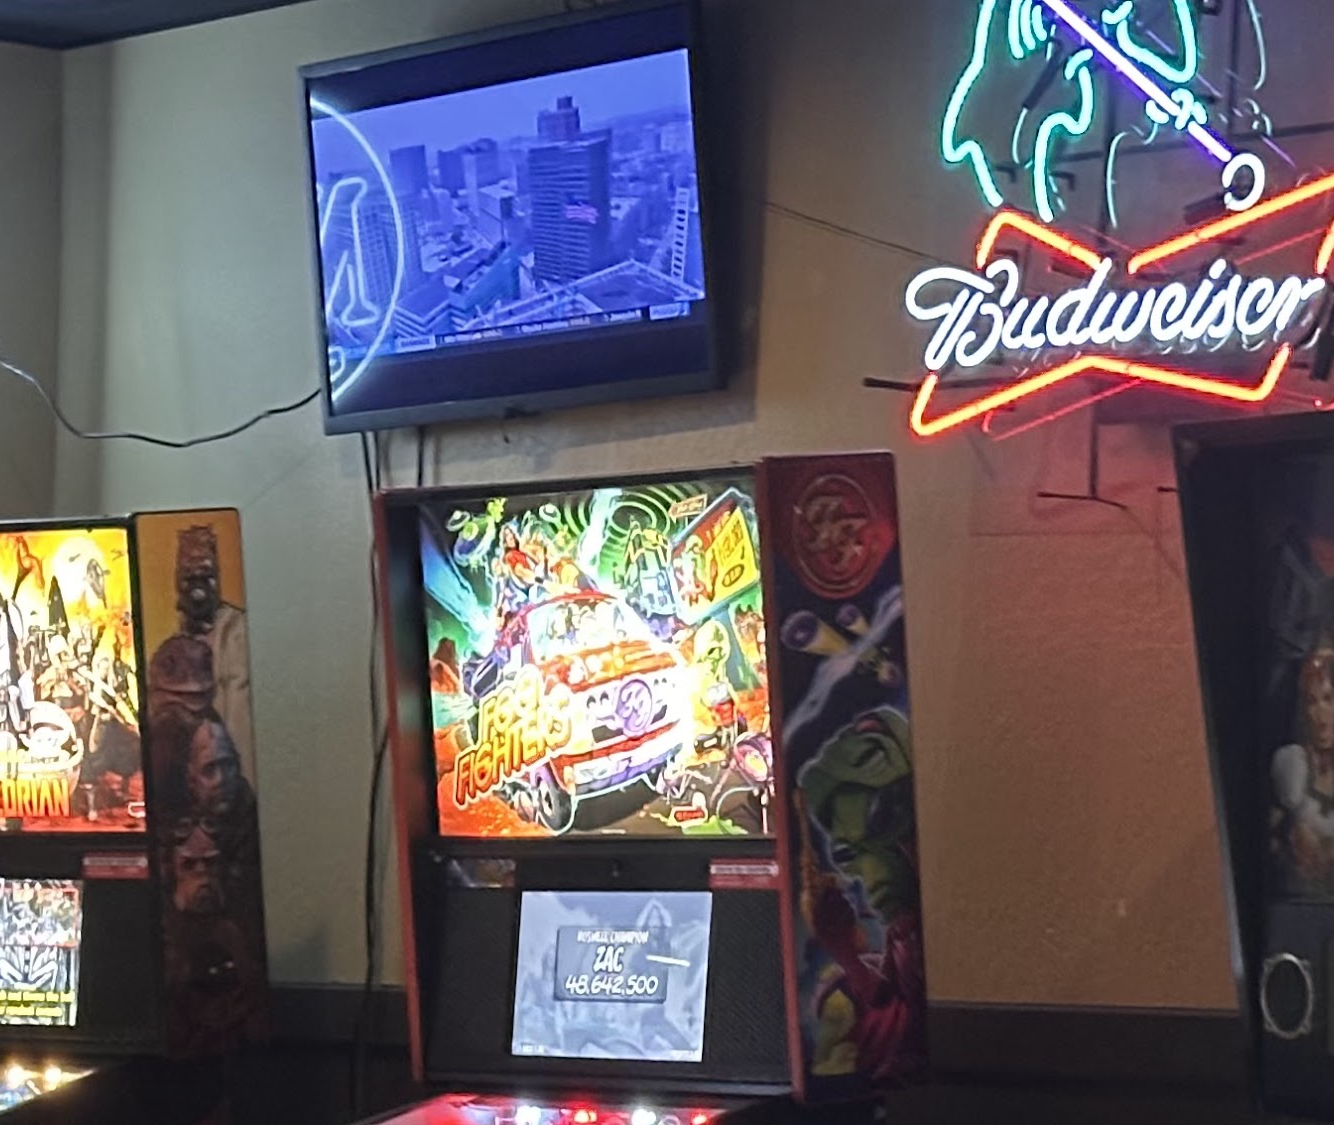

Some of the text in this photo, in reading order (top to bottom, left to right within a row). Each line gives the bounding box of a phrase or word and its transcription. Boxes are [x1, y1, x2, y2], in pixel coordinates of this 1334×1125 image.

[905, 257, 1325, 371] Budweiser
[455, 690, 572, 806] FIGHTERS
[481, 666, 543, 742] FOO
[593, 945, 624, 973] ZAC
